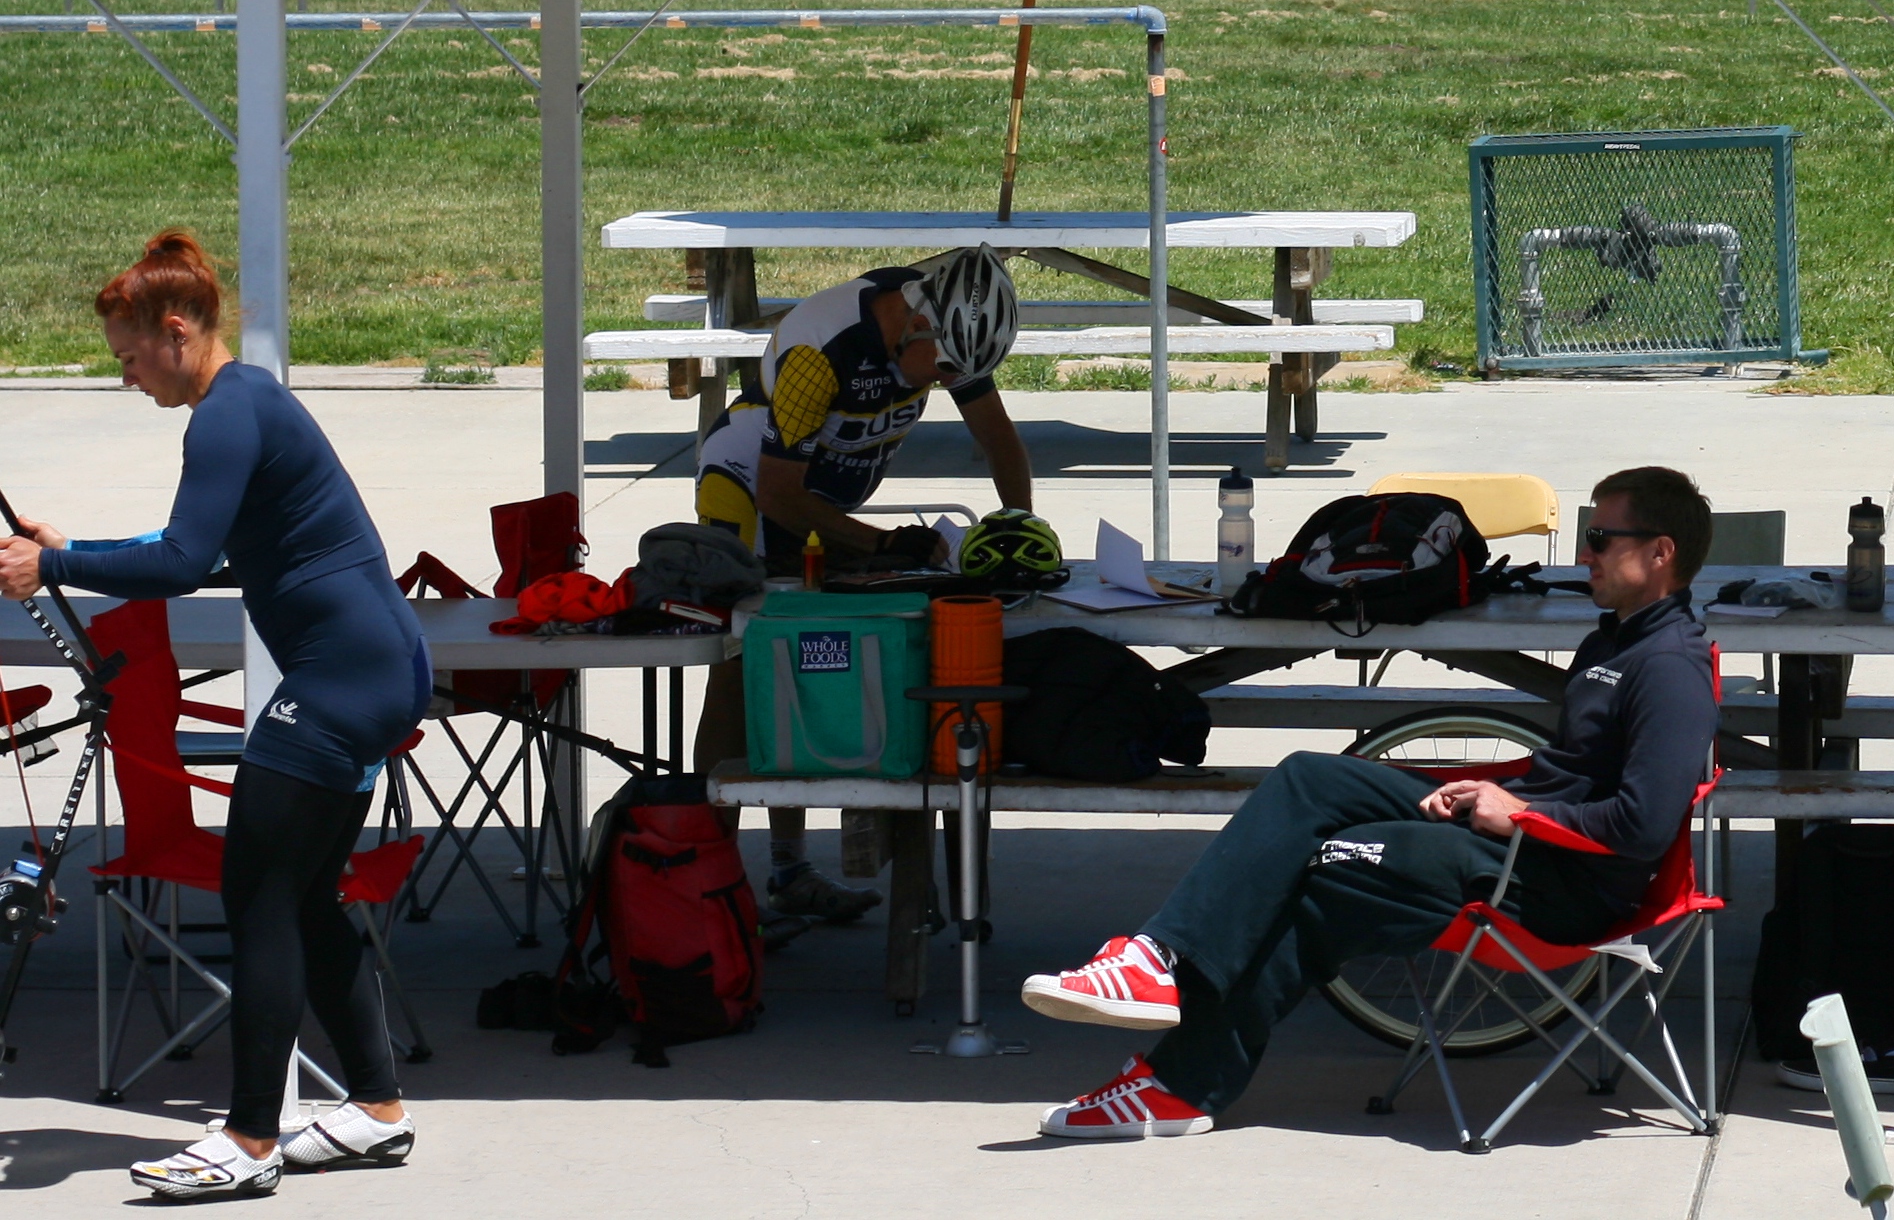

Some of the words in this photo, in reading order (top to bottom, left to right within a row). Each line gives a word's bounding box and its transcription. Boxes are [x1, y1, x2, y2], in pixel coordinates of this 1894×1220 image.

[851, 374, 892, 391] Signs
[857, 391, 867, 401] 4
[870, 388, 882, 400] U
[801, 640, 850, 653] WHOLE
[803, 652, 848, 664] FOODS
